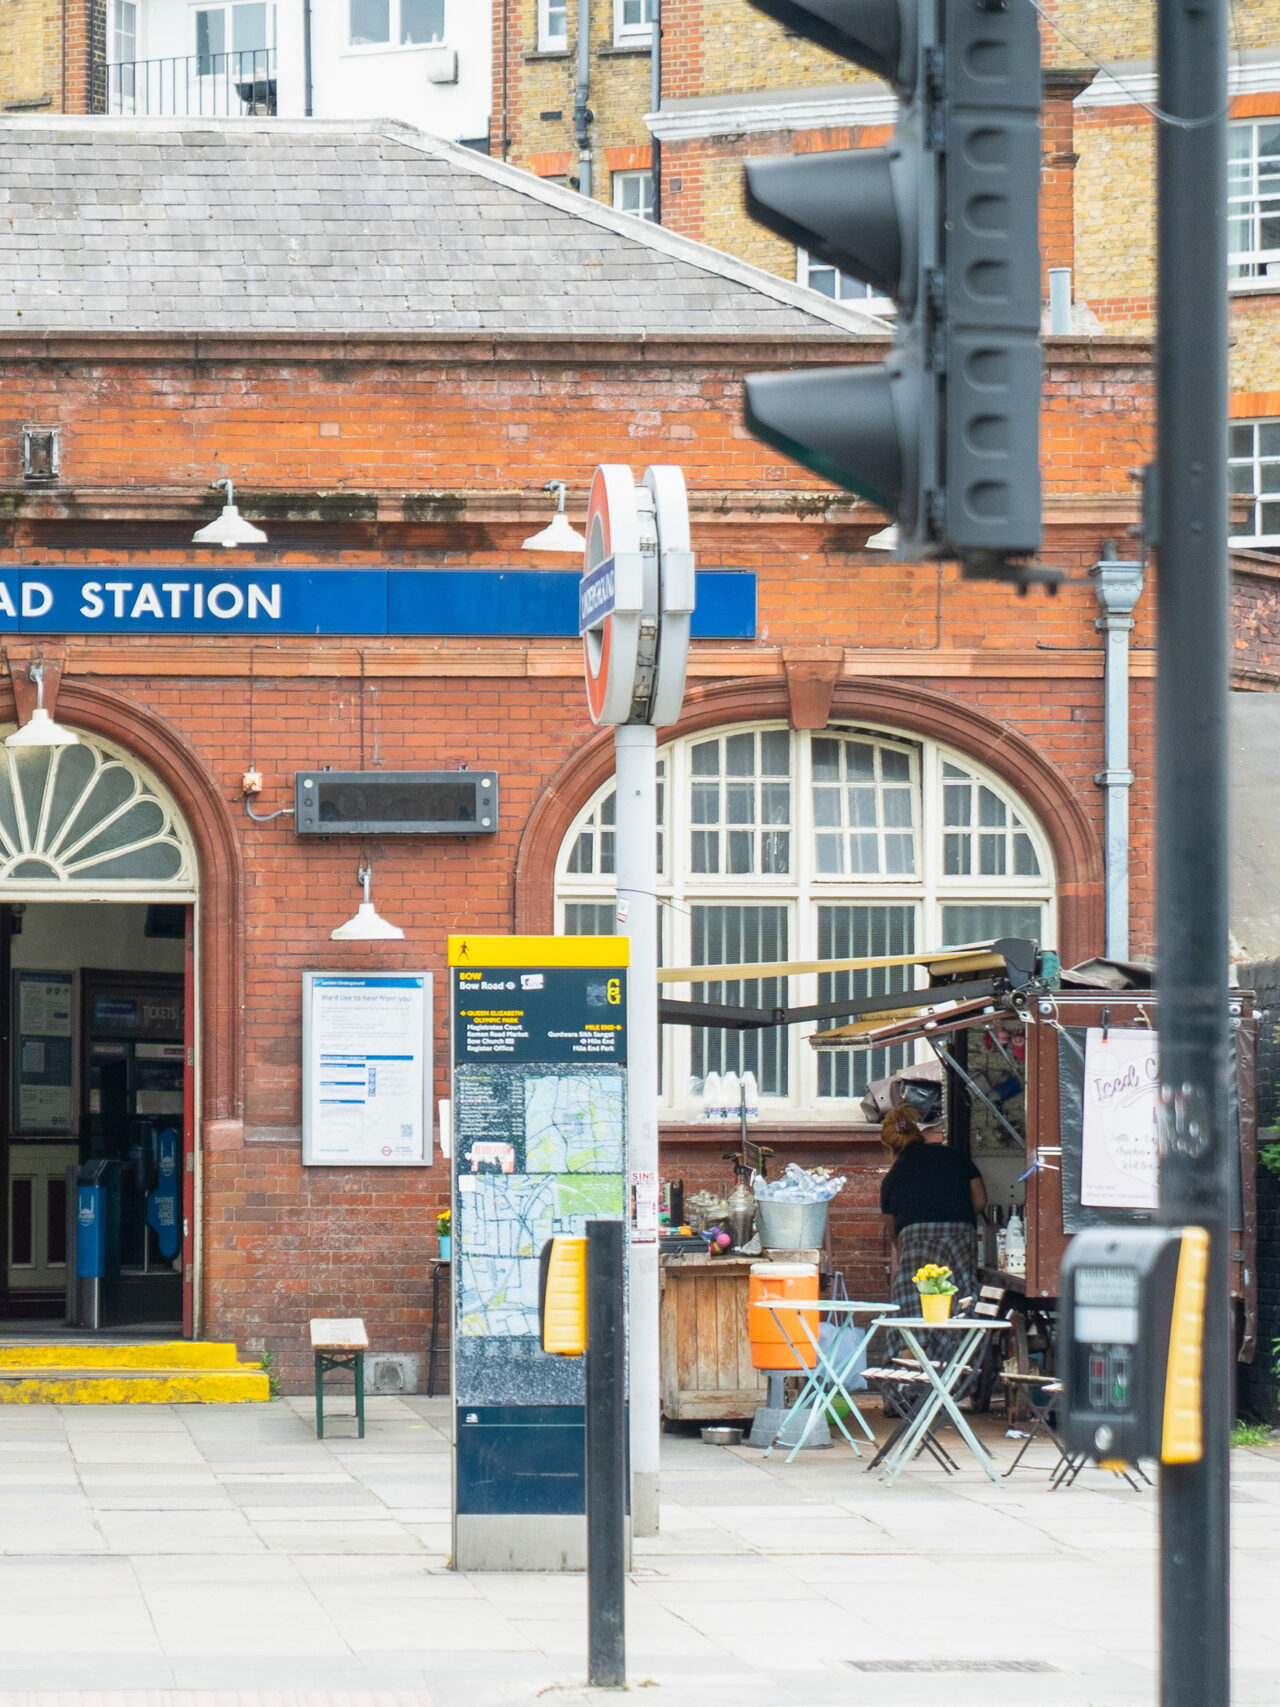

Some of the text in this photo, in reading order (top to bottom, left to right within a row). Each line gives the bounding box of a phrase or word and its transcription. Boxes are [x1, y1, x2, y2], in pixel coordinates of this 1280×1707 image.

[80, 582, 281, 618] STATION
[459, 972, 482, 980] BOW
[459, 981, 504, 990] Bow Road
[142, 1006, 176, 1019] TICKETS
[1094, 1065, 1139, 1101] Iced
